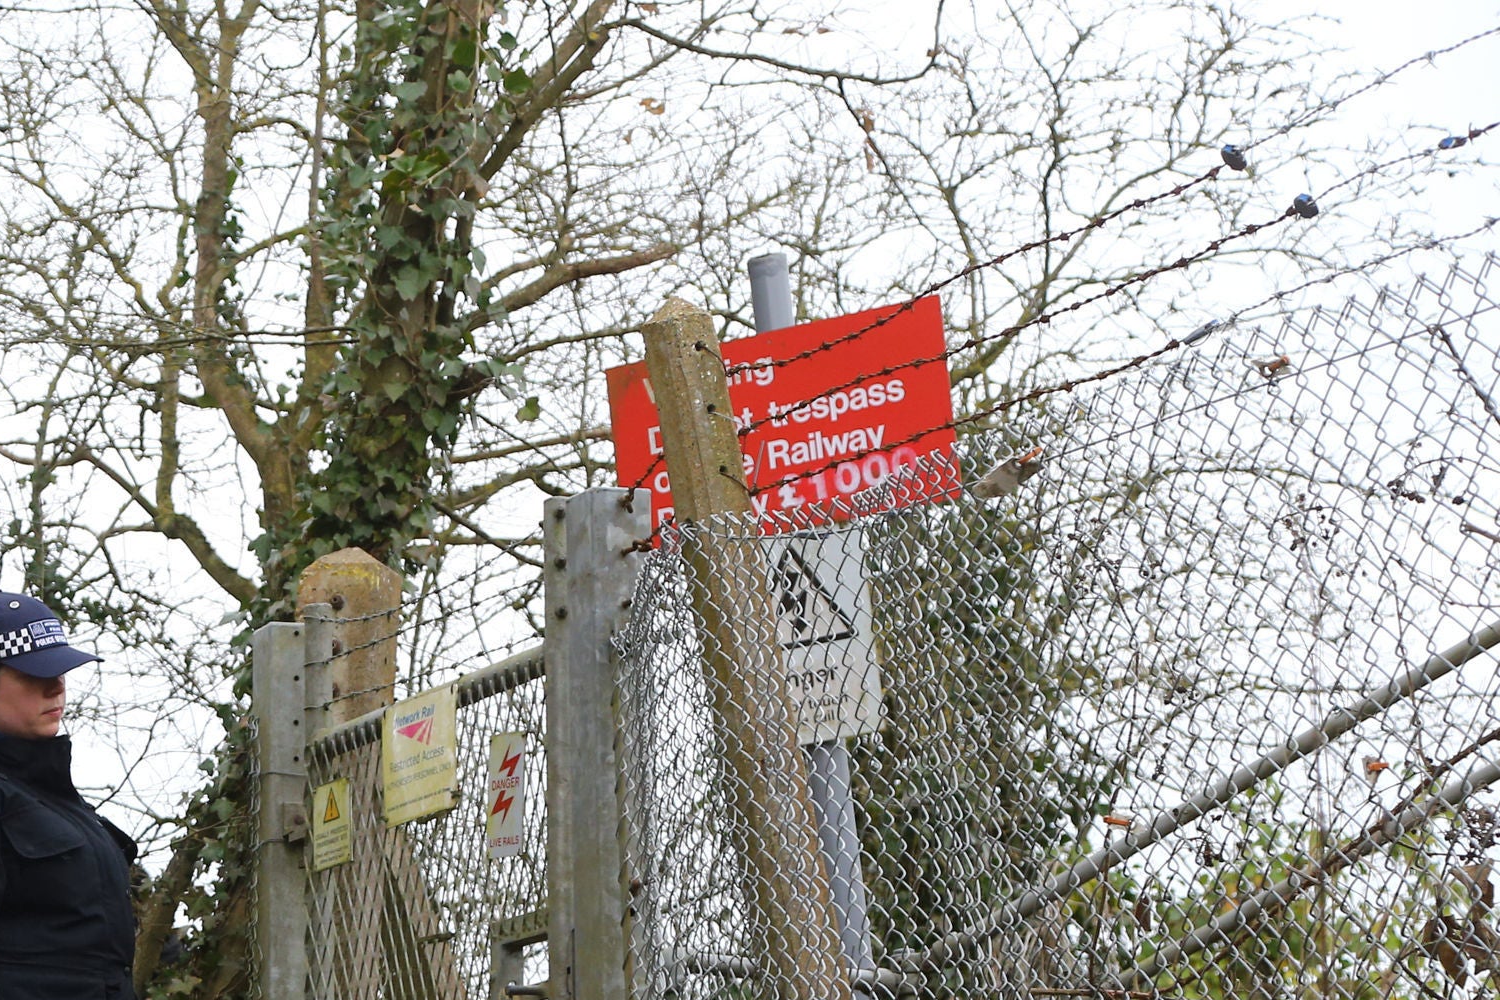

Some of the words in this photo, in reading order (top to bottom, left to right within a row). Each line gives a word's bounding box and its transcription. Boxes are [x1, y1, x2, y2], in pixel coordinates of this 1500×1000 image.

[647, 425, 665, 455] D
[767, 378, 906, 428] trespass
[766, 424, 886, 470] Railway
[777, 446, 918, 509] £1000
[787, 666, 839, 690] nger
[395, 709, 420, 729] Network
[421, 704, 436, 718] Rail
[389, 752, 421, 773] Restricted
[422, 745, 445, 761] Access
[491, 777, 520, 791] DANGER
[489, 837, 502, 848] LIVE
[502, 835, 520, 847] RAILS
